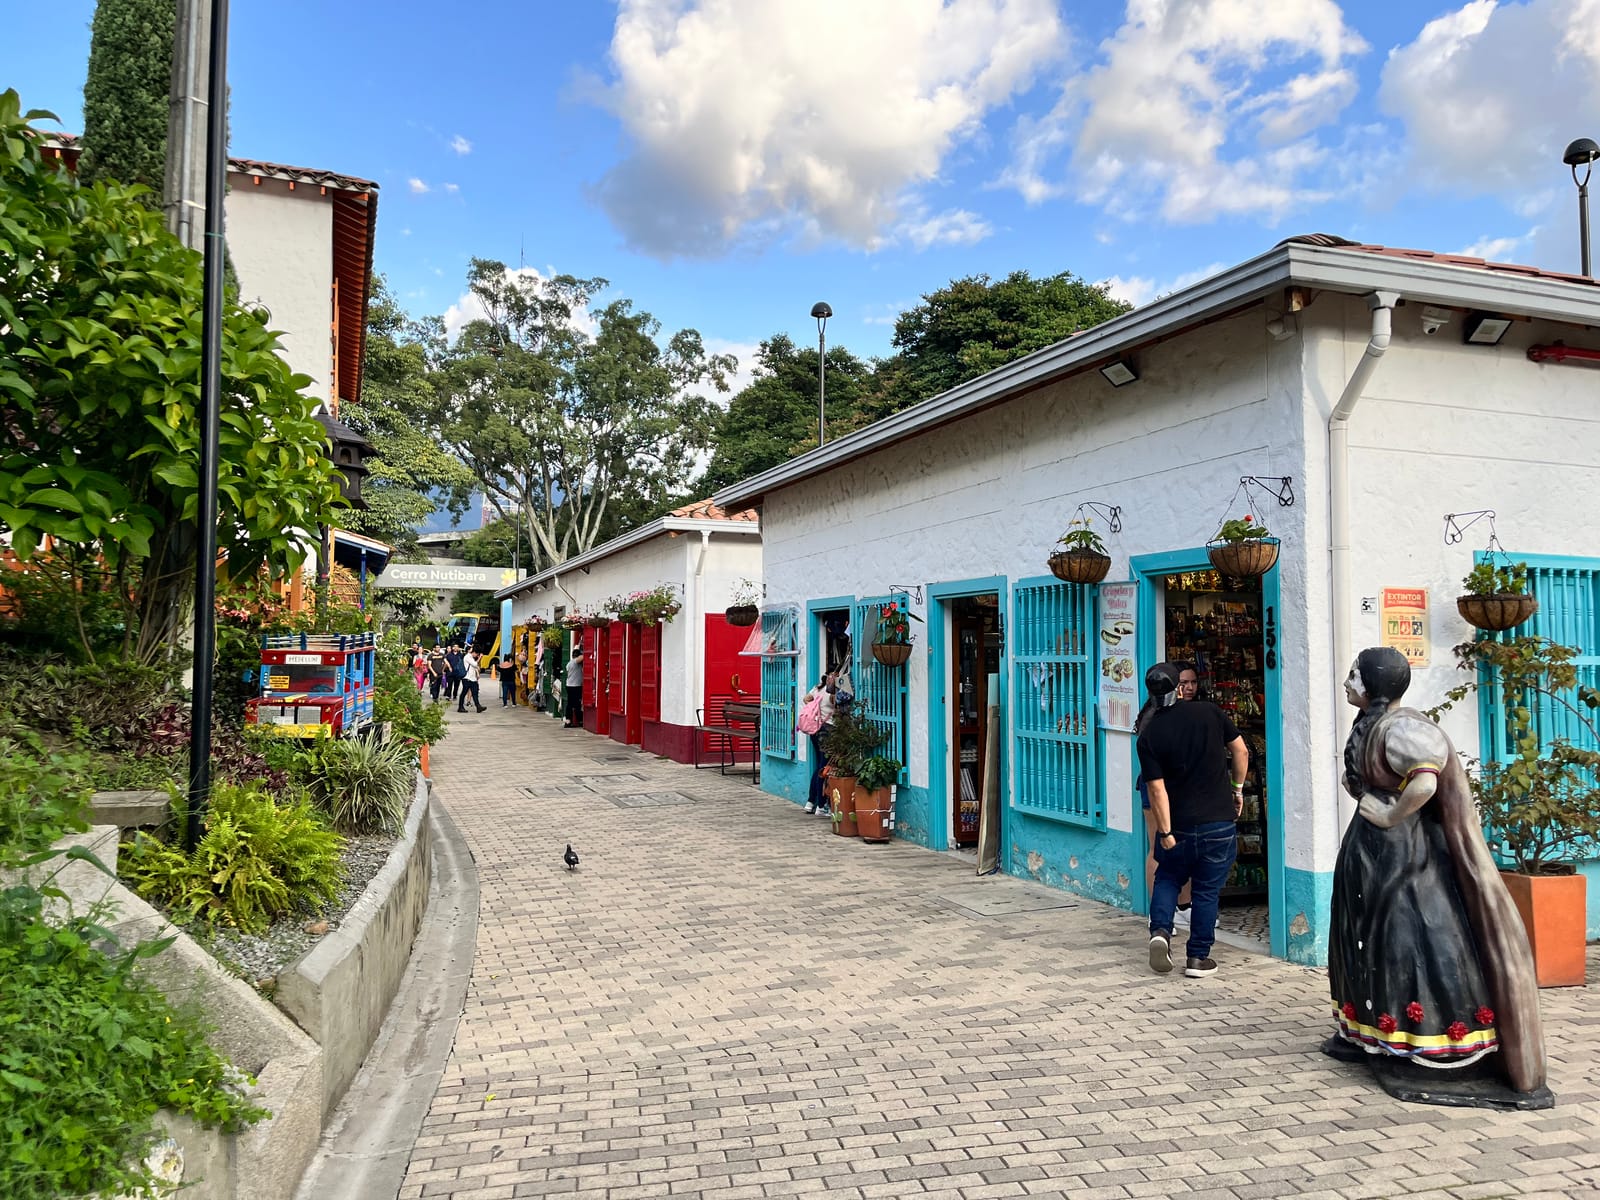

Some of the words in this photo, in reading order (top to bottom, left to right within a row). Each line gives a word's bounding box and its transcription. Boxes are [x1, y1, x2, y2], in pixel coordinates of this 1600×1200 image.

[390, 569, 427, 579] Cerro
[431, 570, 486, 581] Nutibara
[1387, 593, 1422, 601] EXTINTOR
[1265, 606, 1276, 670] 156
